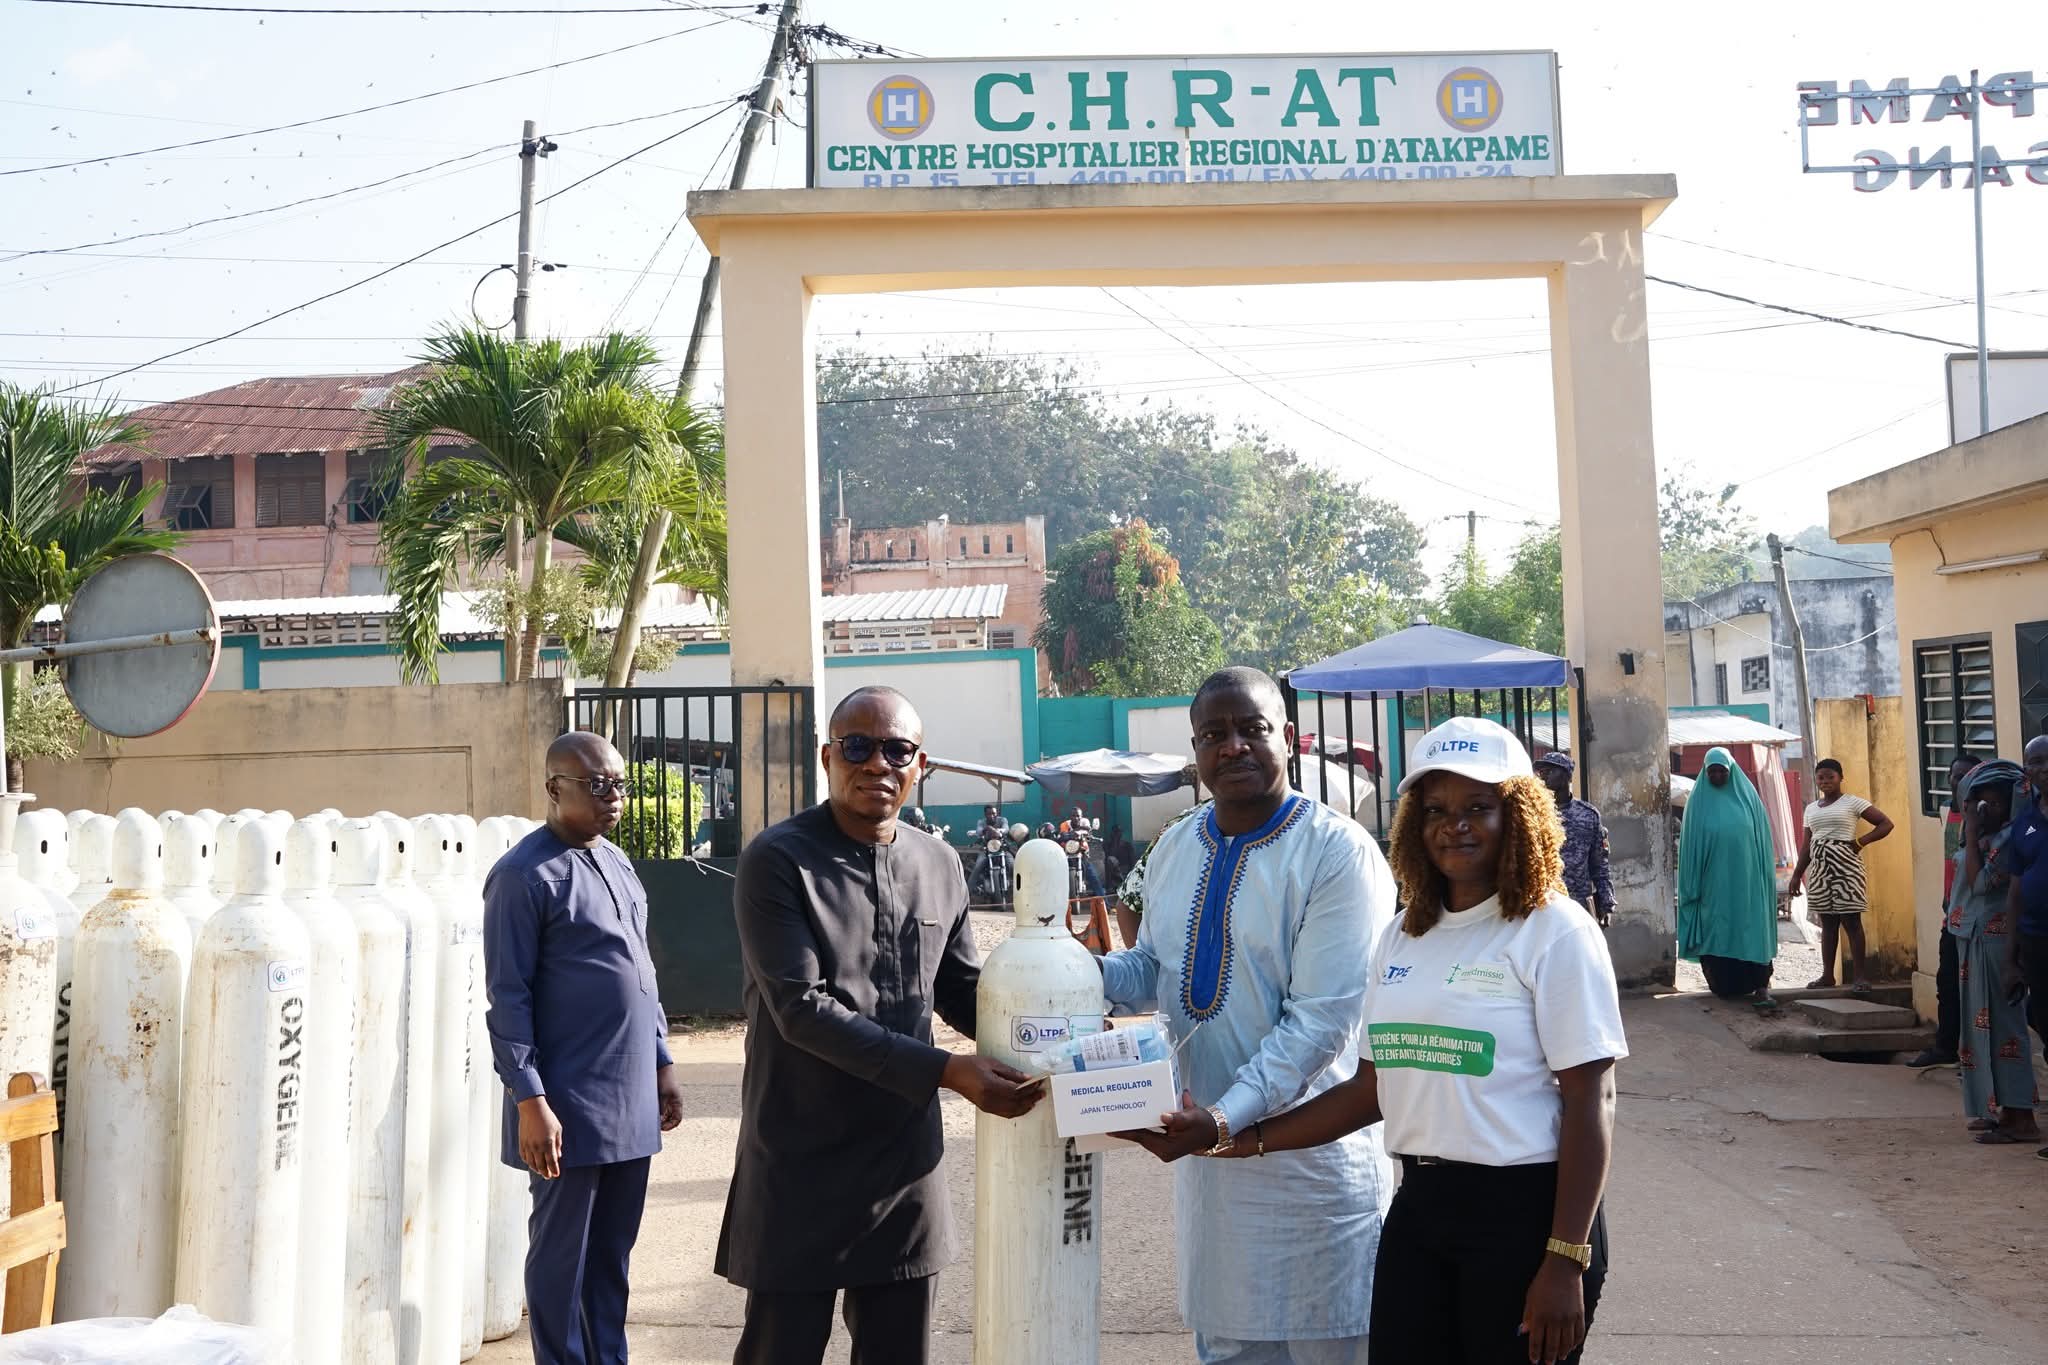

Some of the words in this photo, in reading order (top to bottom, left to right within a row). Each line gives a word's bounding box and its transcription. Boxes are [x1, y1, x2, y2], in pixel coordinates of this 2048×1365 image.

[826, 144, 957, 171] CENTRE
[966, 141, 1180, 170] HOSPITALIER
[1190, 139, 1347, 166] REGIONAL
[1356, 134, 1551, 164] D'ATAKPAME
[1441, 740, 1480, 752] LTPE
[1401, 1033, 1419, 1045] POUR
[1419, 1034, 1428, 1046] LA
[1429, 1034, 1483, 1053] RÉANIMATION
[1385, 1048, 1416, 1060] ENFANTS
[1416, 1048, 1462, 1066] DÉFAVORISÉS
[1071, 1085, 1105, 1096] MEDICAL
[1106, 1079, 1152, 1092] REGULATOR
[1080, 1106, 1101, 1115] JAPAN
[1102, 1100, 1147, 1113] TECHNOLOGY
